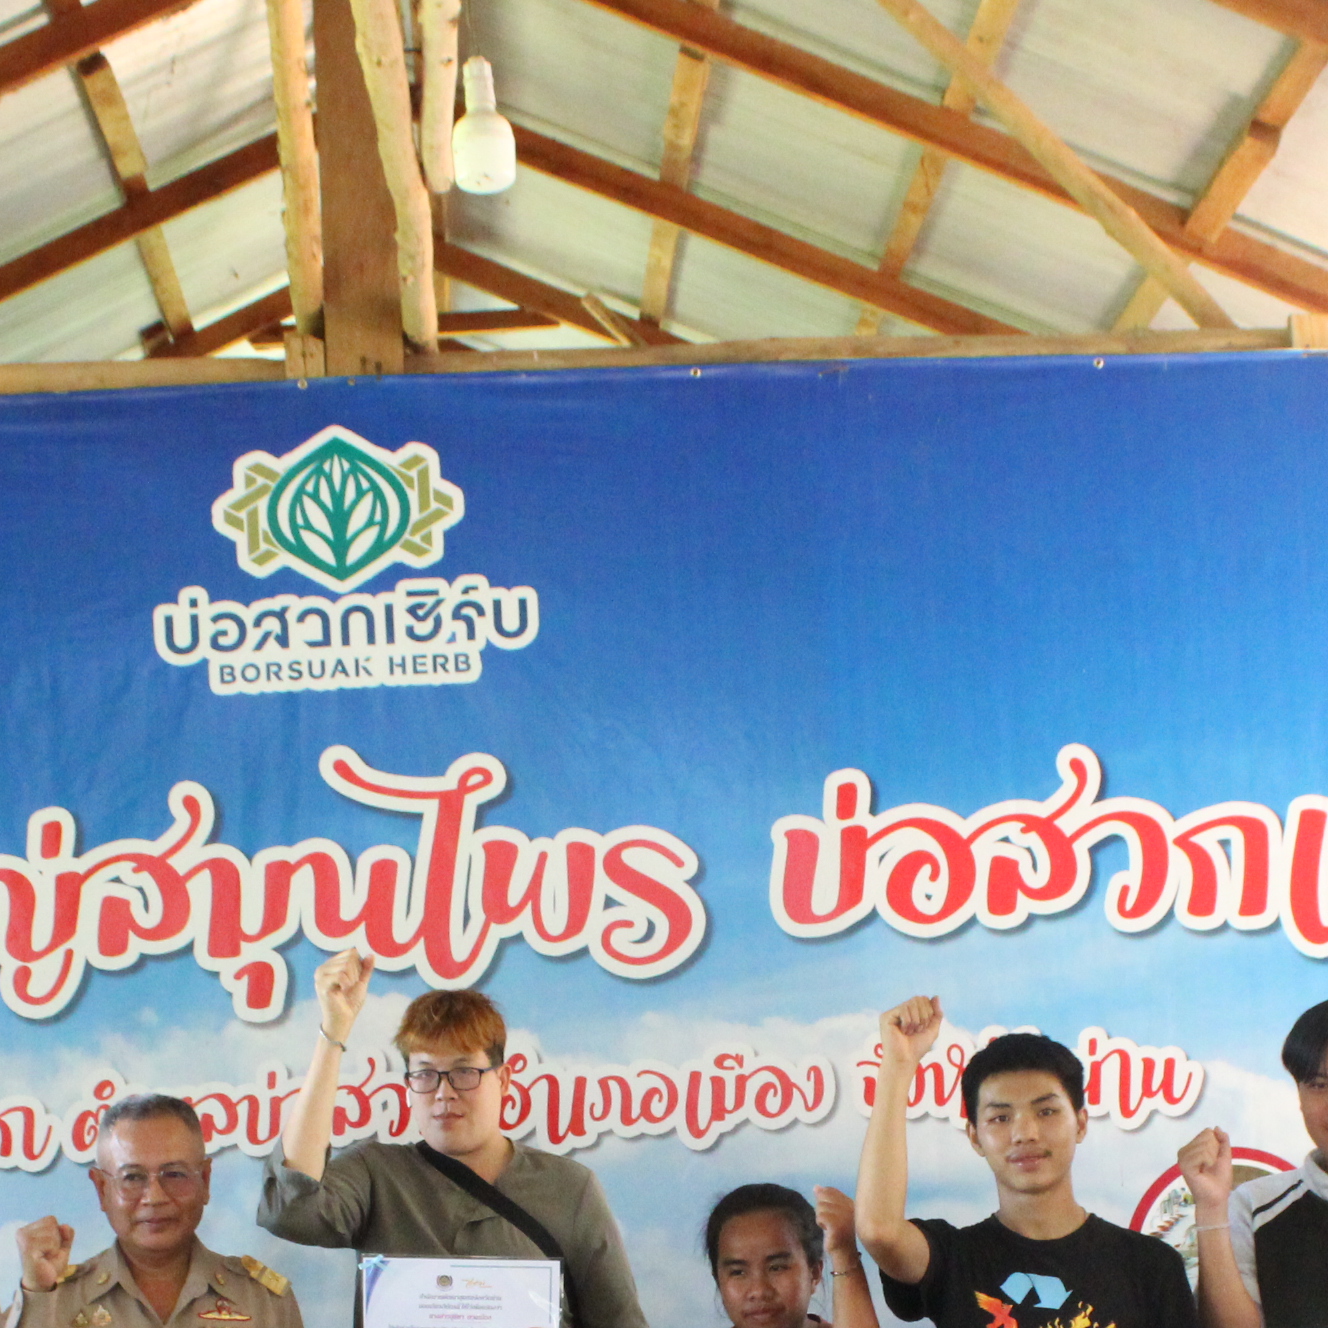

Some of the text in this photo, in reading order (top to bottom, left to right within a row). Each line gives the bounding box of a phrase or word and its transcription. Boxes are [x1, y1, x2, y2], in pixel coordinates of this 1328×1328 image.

[164, 586, 528, 654] บ่อสวกเฮิร์บ
[219, 652, 472, 685] BORSUAK HERB
